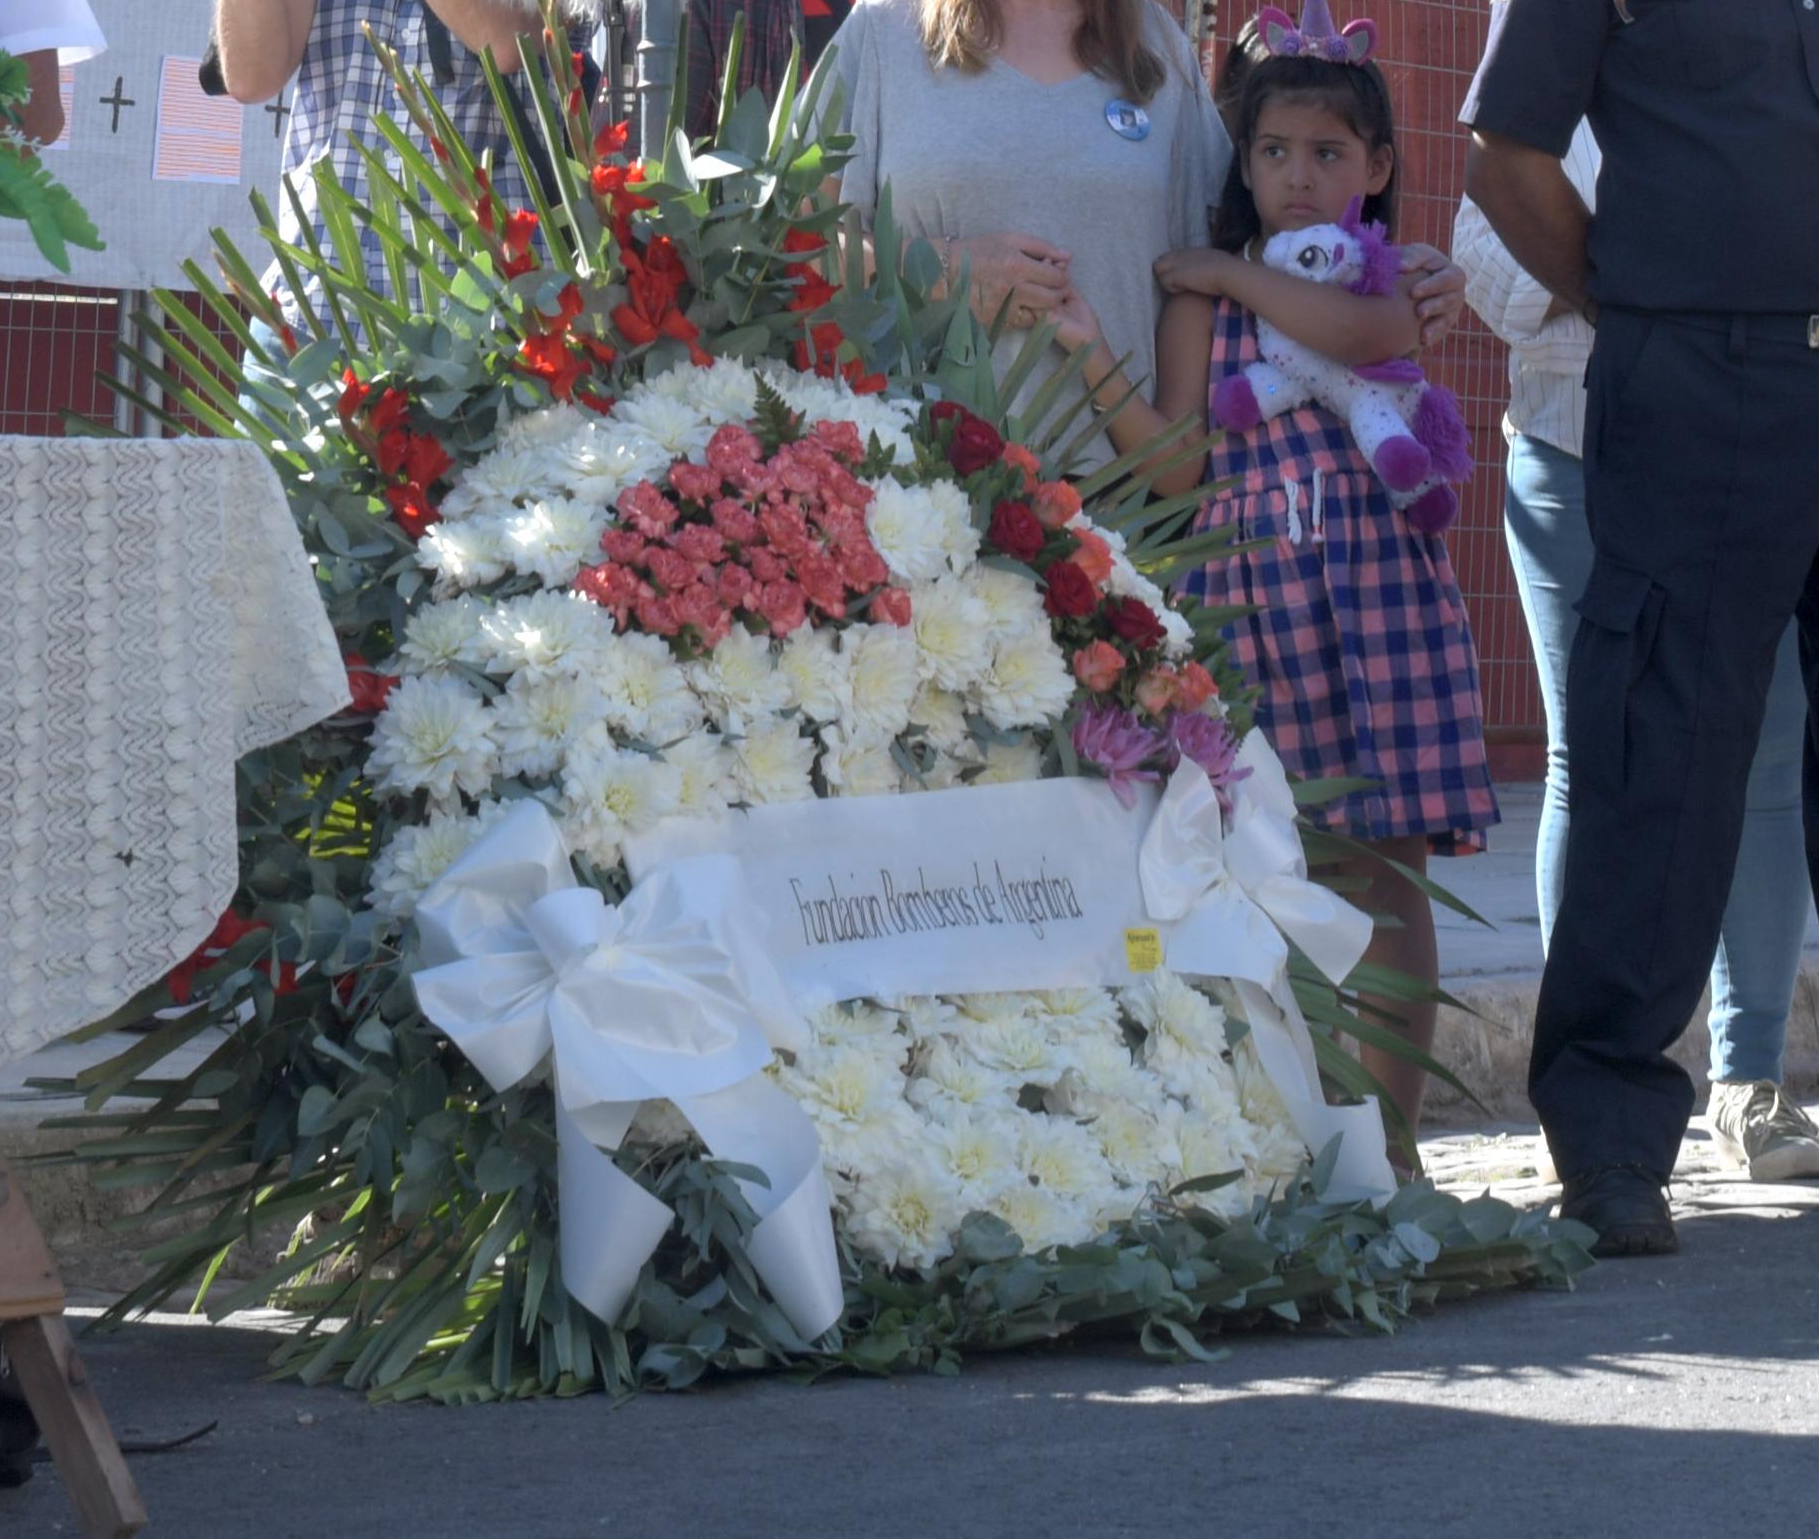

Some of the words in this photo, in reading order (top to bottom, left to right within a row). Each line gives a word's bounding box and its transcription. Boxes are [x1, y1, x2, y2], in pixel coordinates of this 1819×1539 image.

[789, 872, 892, 946] Fundacion
[881, 865, 980, 935] Bomberos
[973, 861, 1003, 924] de
[994, 854, 1084, 941] Argentina
